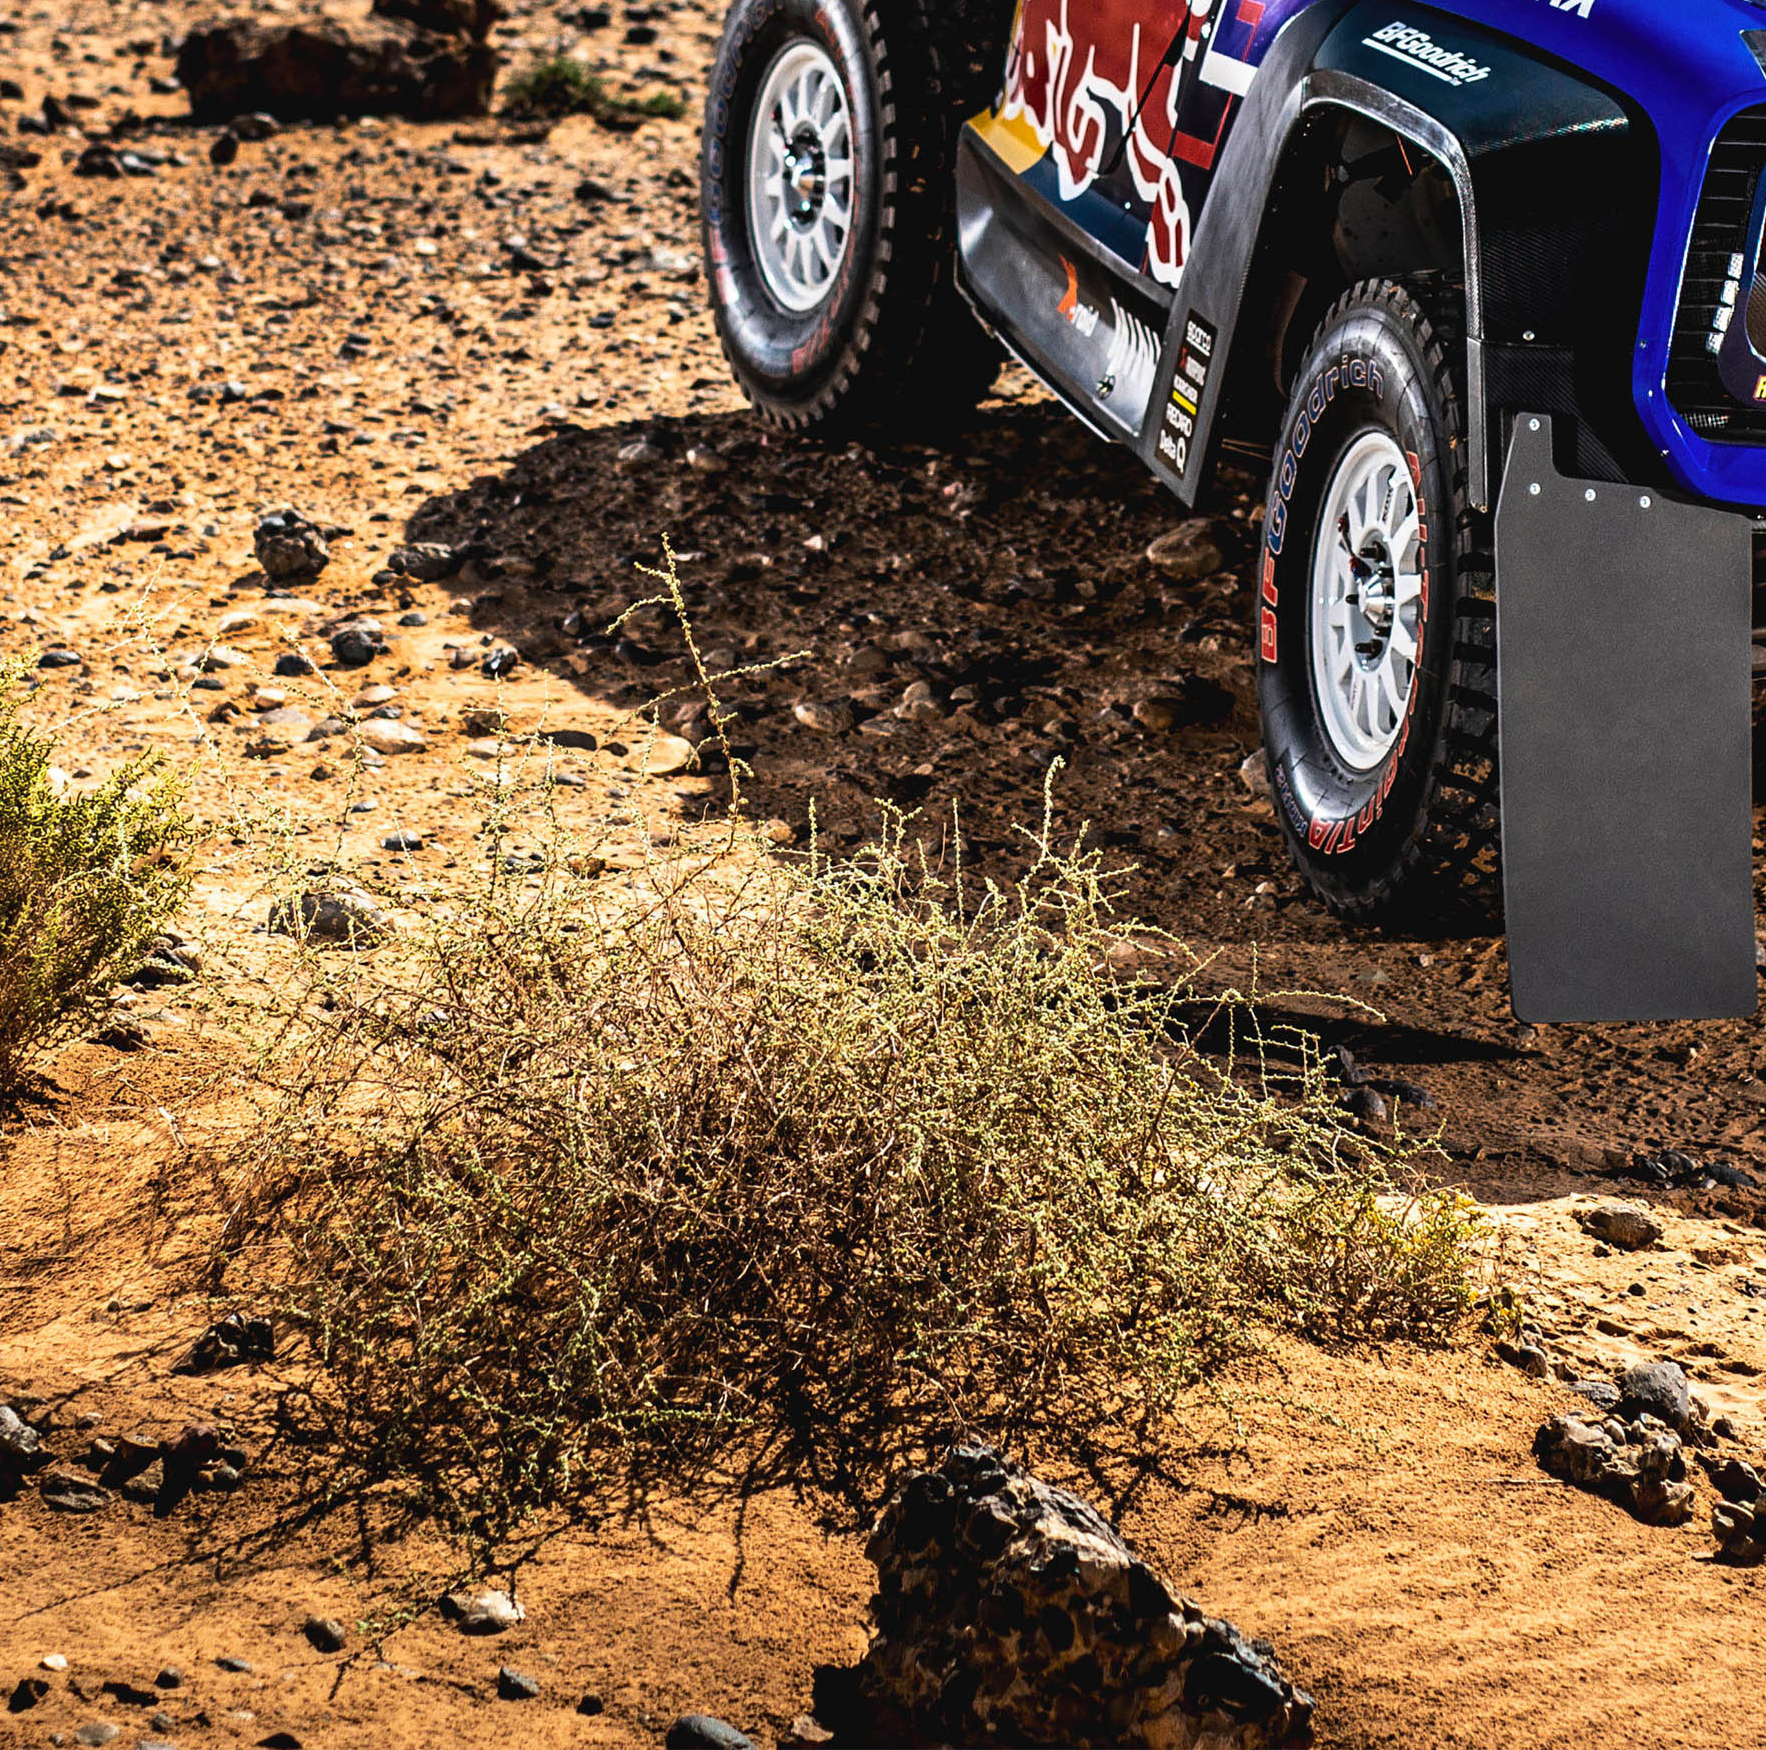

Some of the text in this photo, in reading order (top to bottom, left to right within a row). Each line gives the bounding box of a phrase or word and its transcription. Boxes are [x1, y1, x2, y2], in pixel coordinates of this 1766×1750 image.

[1372, 21, 1491, 83] BFGoodrich
[1261, 354, 1383, 663] BFGoodrich
[1308, 816, 1356, 854] T/A
